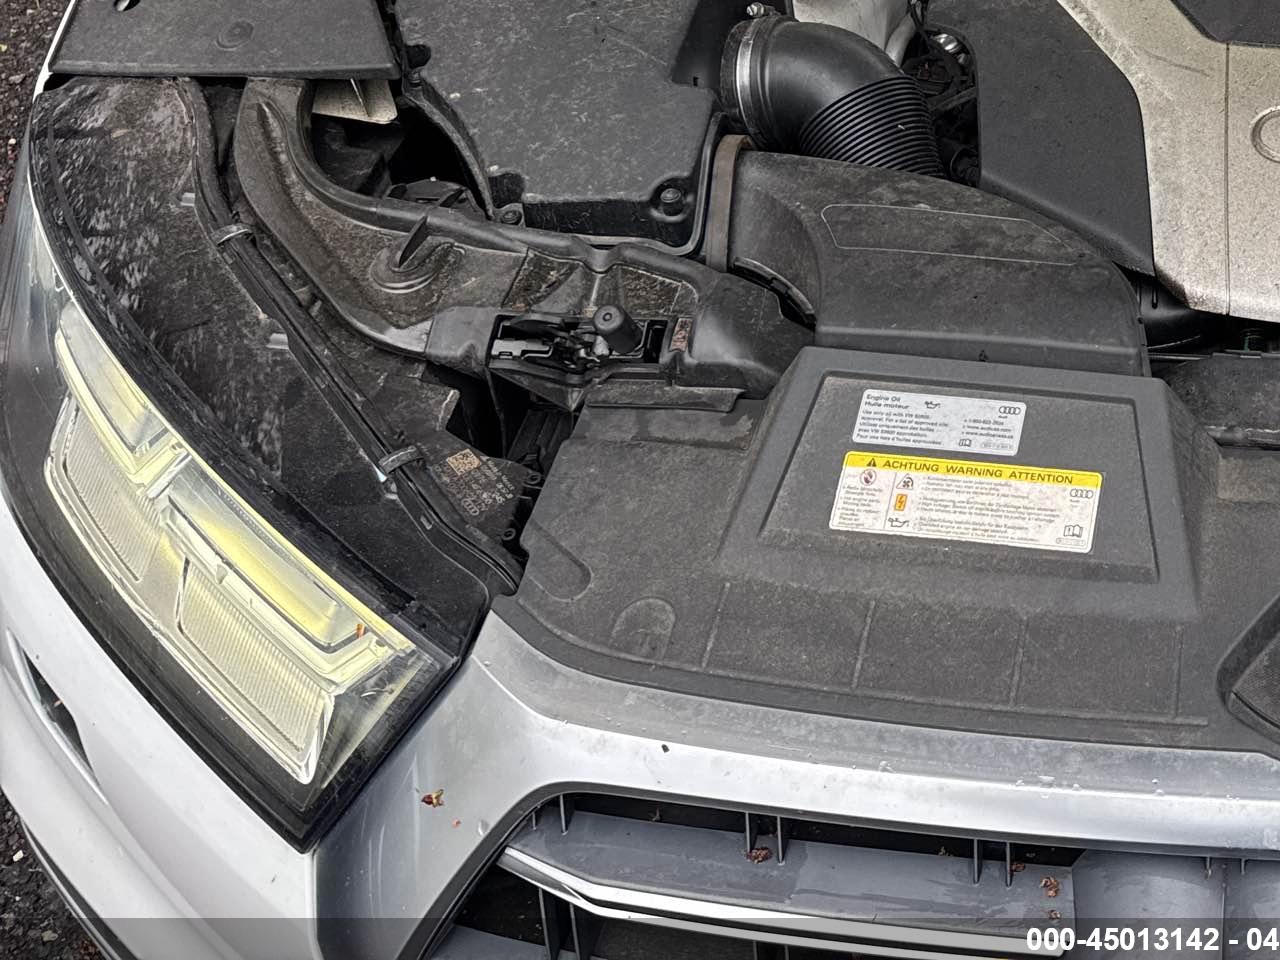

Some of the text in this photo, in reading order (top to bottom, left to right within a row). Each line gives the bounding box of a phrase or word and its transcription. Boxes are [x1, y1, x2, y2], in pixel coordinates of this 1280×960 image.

[882, 460, 939, 472] ACHTUNG
[945, 464, 1003, 478] WARNING
[1008, 471, 1073, 484] ATTENTION
